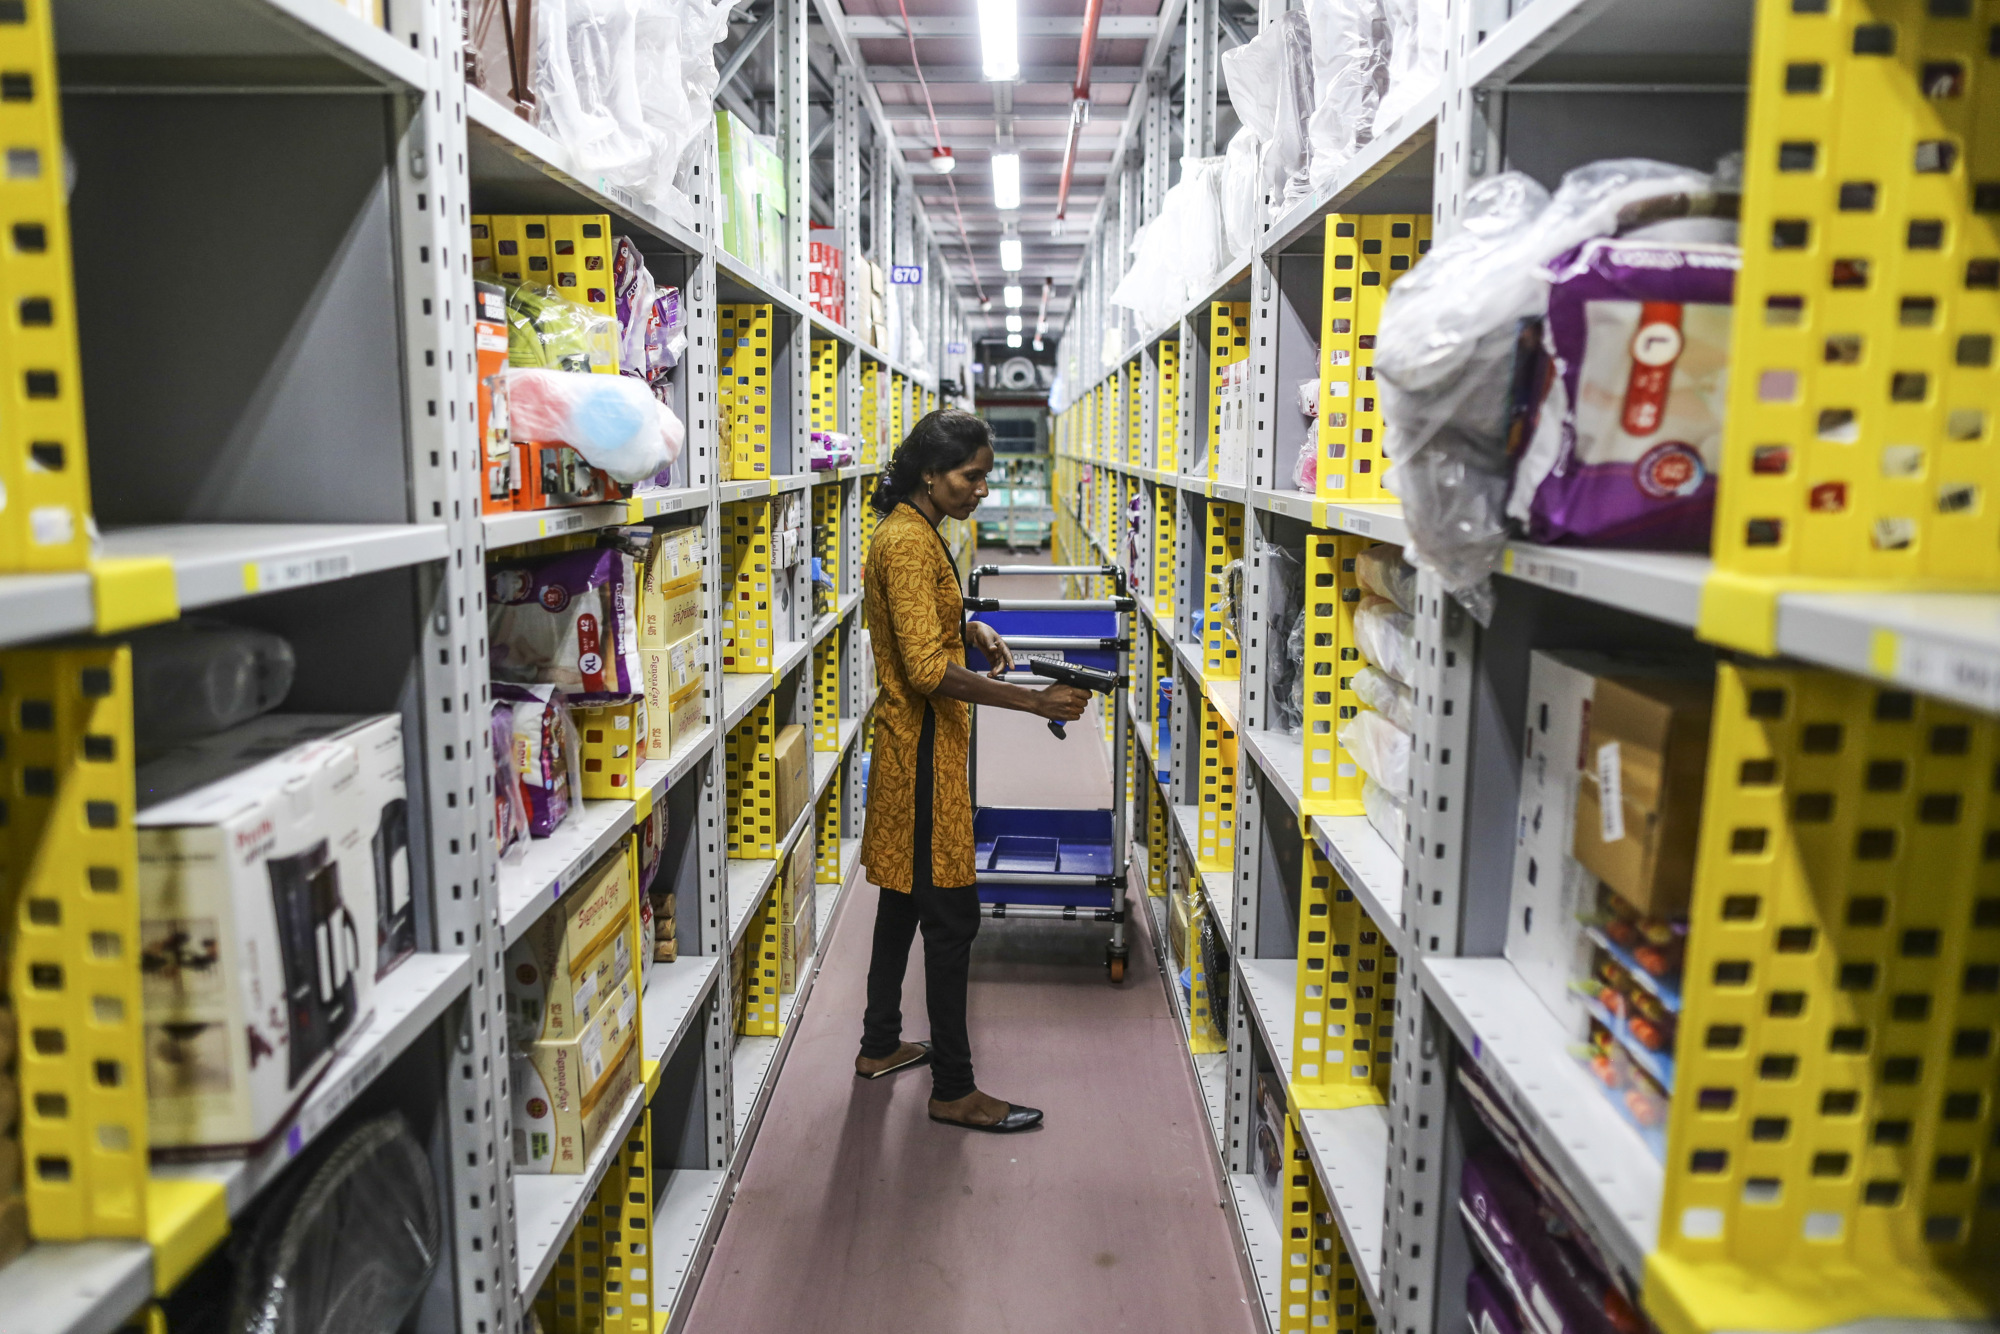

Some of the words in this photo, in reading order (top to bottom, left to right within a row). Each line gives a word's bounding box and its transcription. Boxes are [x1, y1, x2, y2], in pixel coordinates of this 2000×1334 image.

[893, 267, 920, 283] 670
[580, 619, 590, 632] 42
[584, 655, 596, 672] XL
[650, 654, 660, 687] Signora
[651, 687, 661, 708] Care
